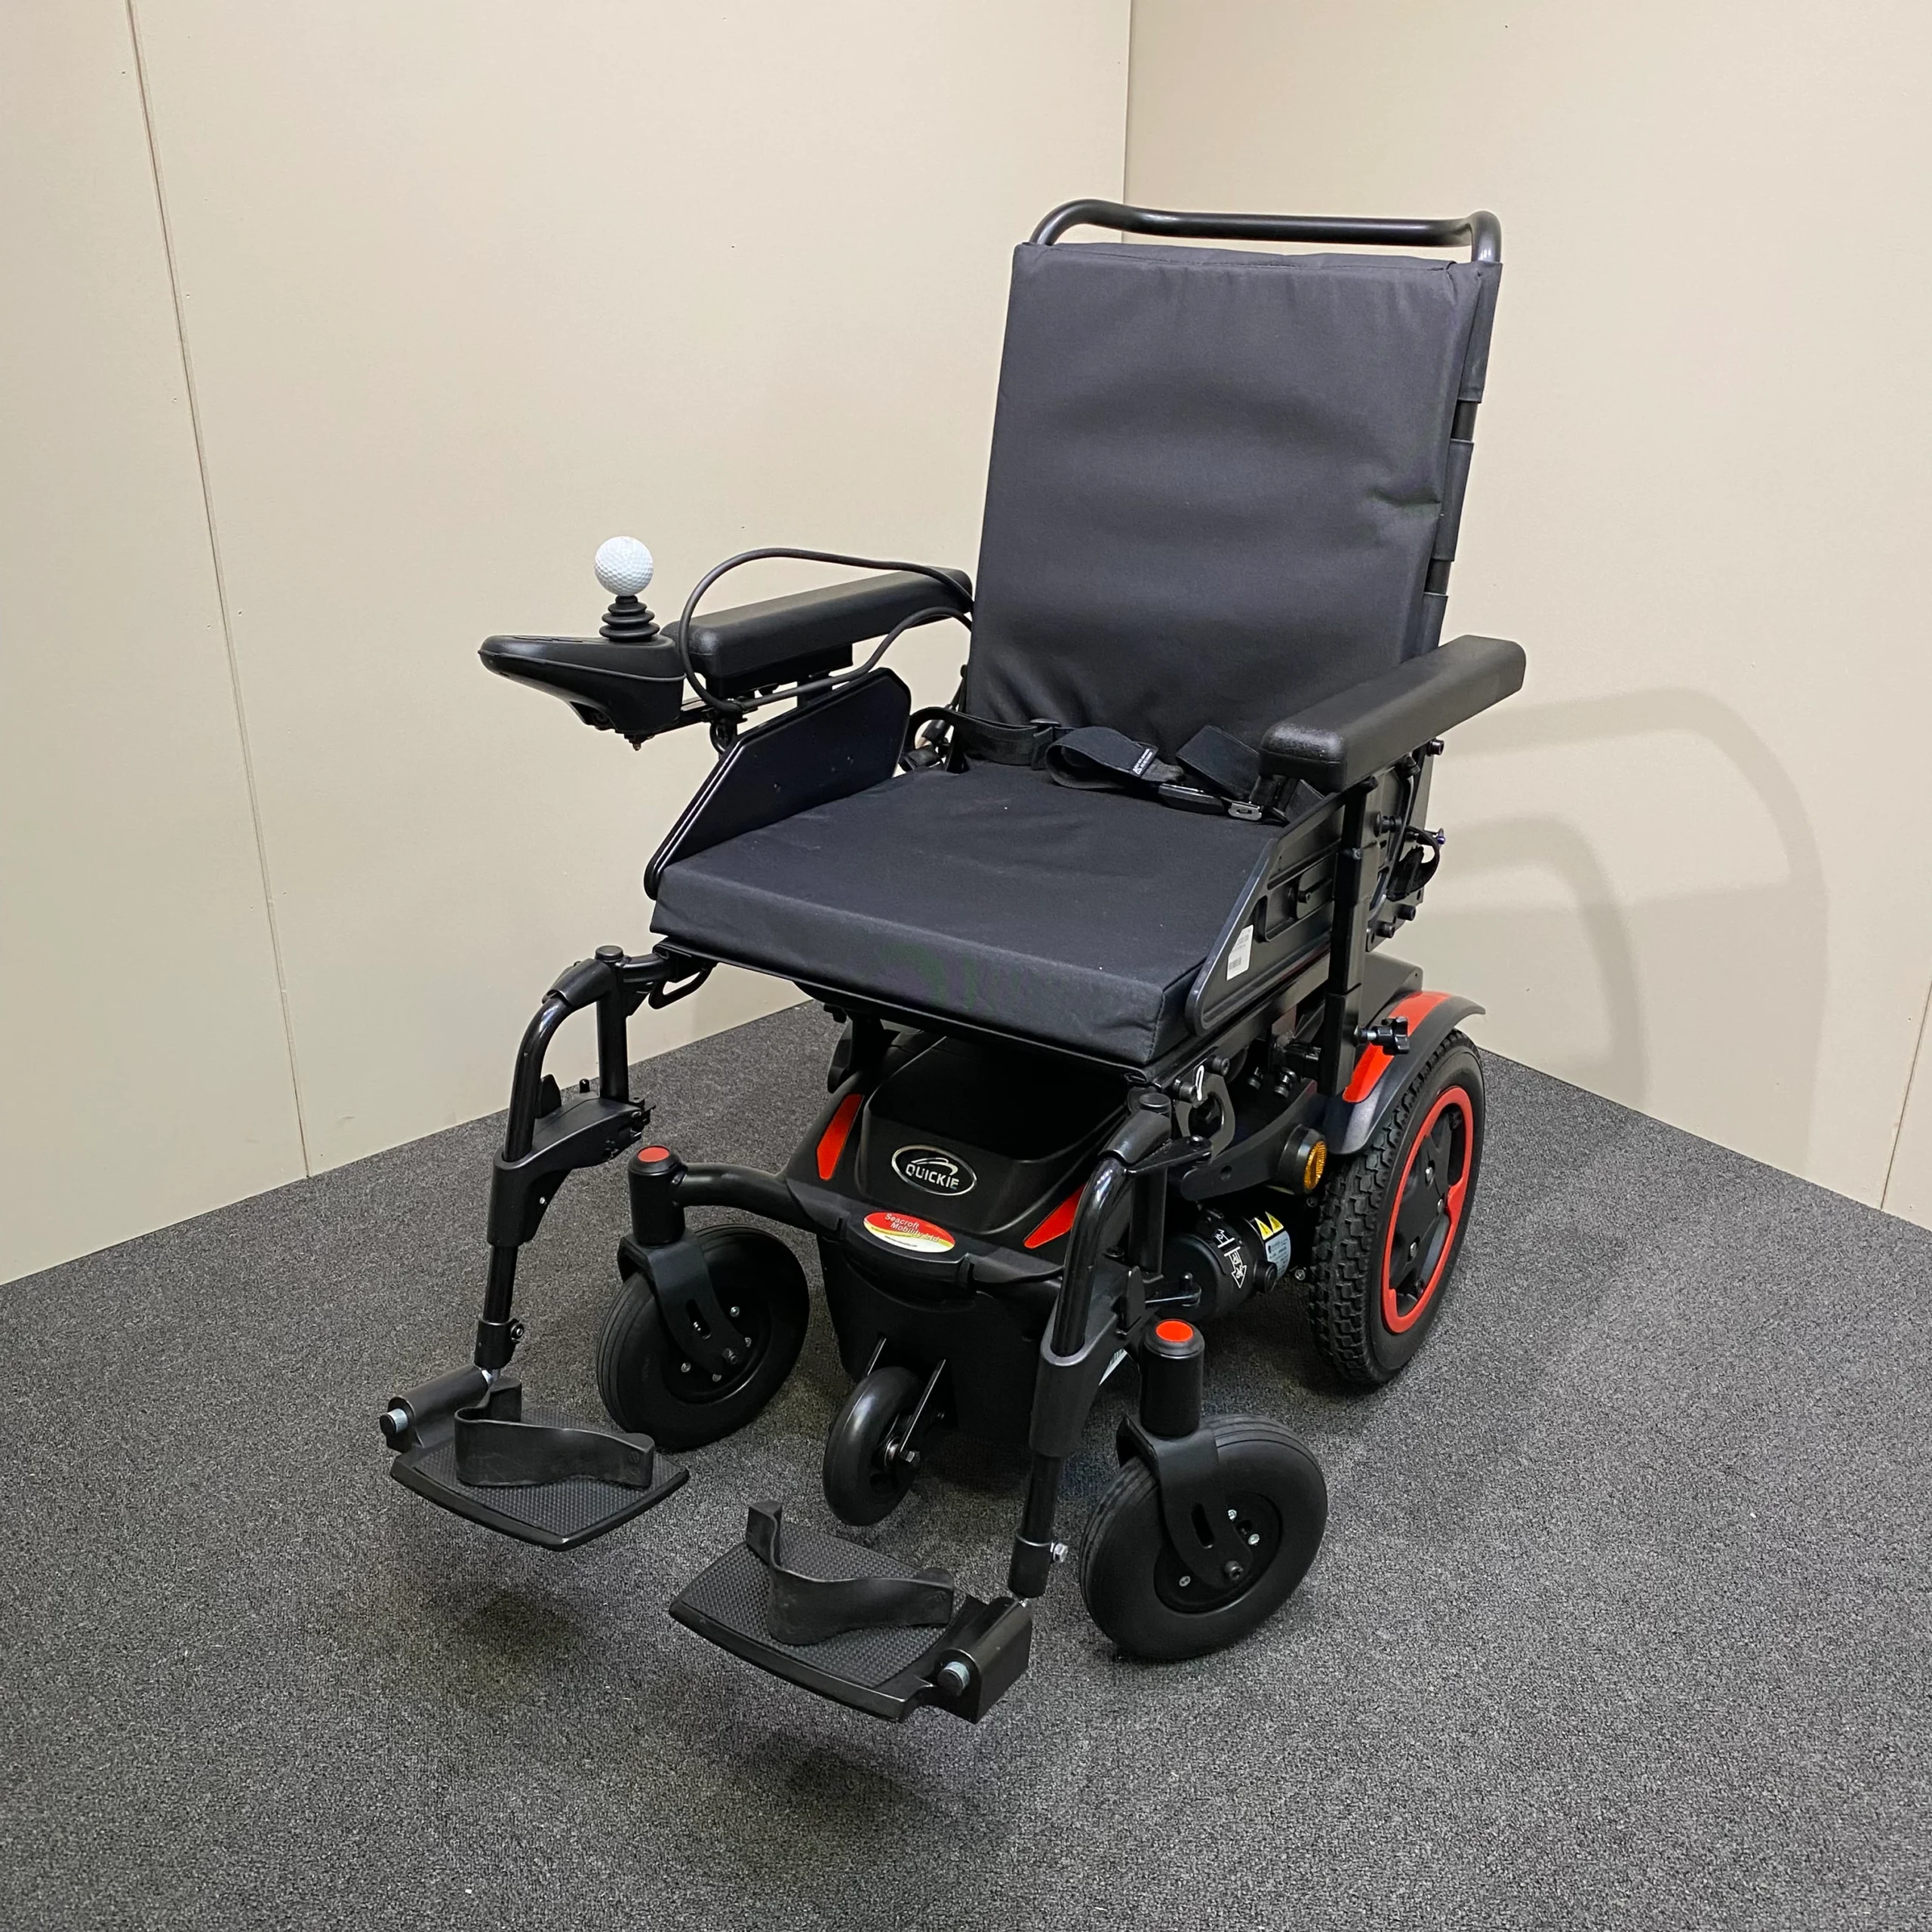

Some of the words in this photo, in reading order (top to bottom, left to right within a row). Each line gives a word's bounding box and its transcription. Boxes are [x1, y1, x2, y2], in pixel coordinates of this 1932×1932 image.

[906, 1164, 959, 1190] QUICKIE
[884, 1214, 919, 1229] Seacroft
[891, 1222, 923, 1238] Mobility
